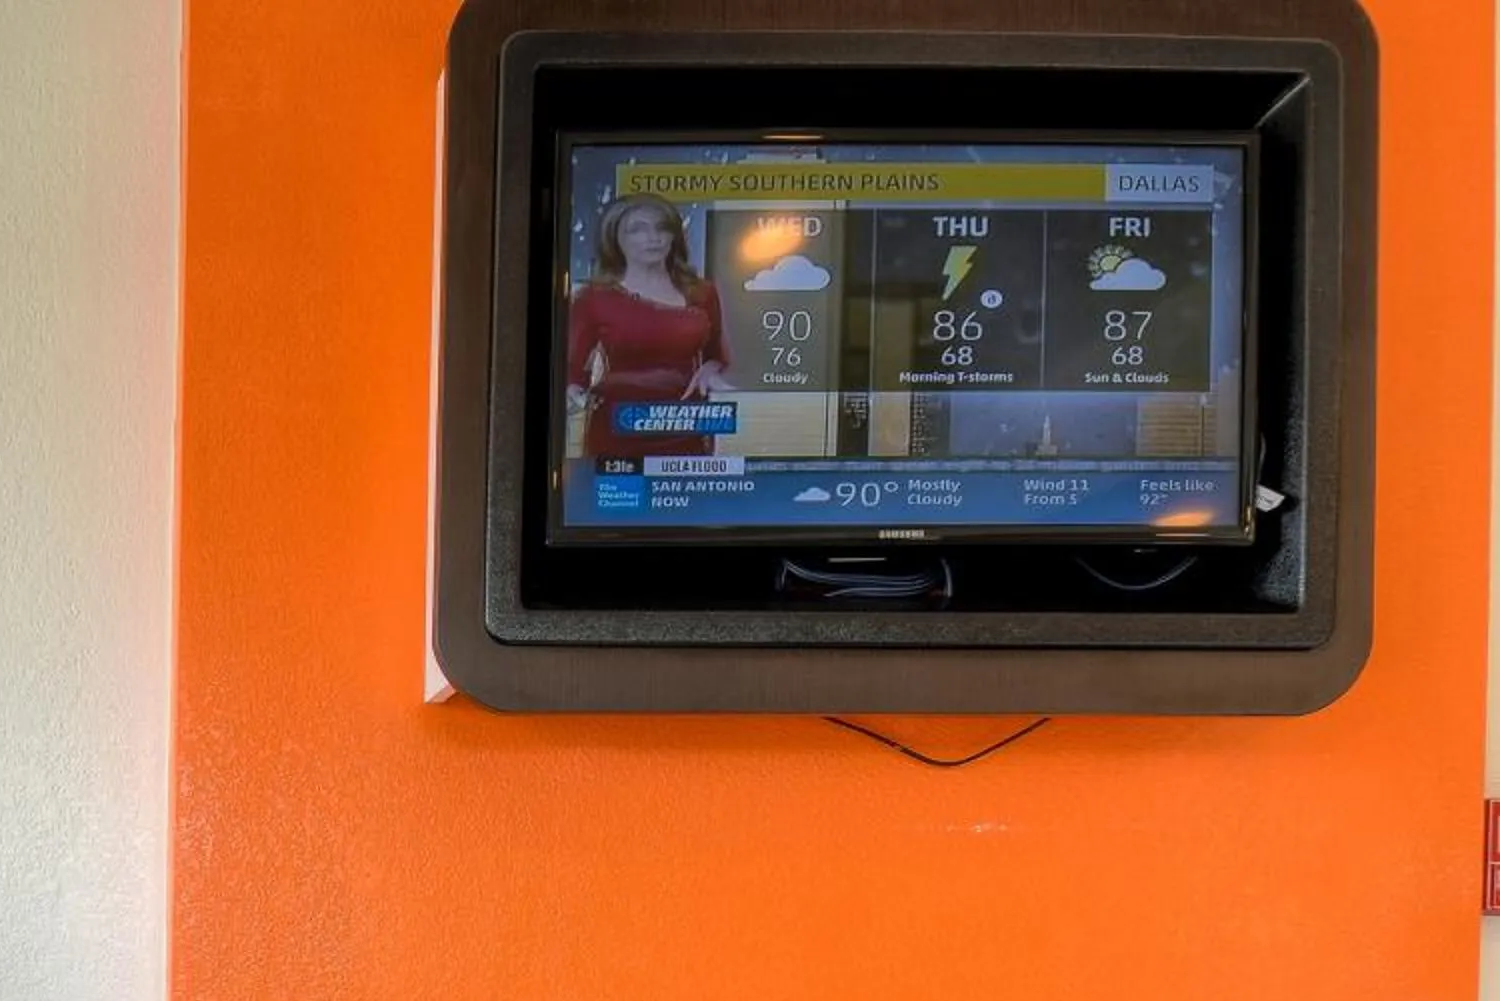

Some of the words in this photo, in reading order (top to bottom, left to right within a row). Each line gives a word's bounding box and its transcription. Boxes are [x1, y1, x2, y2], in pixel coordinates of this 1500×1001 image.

[630, 175, 722, 193] STORMY
[729, 174, 853, 192] SOUTHERN
[861, 173, 940, 191] PLAINS
[1118, 174, 1201, 192] DALLAS
[932, 216, 989, 238] THU
[1109, 216, 1151, 238] FRI
[762, 310, 812, 341] 90
[932, 310, 984, 342] 86
[1104, 310, 1153, 342] 87
[770, 347, 802, 367] 76
[940, 345, 974, 366] 68
[1110, 345, 1144, 366] 68
[762, 371, 809, 385] Cloudy
[899, 371, 954, 385] Morning
[958, 371, 1014, 384] T-storms
[1084, 371, 1109, 384] Sun
[1110, 371, 1123, 383] &
[1124, 371, 1169, 384] Clouds
[648, 404, 734, 419] WEATHER
[633, 418, 696, 432] CENTER
[651, 480, 682, 493] SAN
[685, 480, 756, 493] ANTONIO
[907, 478, 961, 493] Mostly
[1023, 478, 1065, 492] Wind
[1069, 479, 1089, 492] 11
[1140, 478, 1181, 492] Feels
[1184, 478, 1215, 492] like
[651, 496, 690, 508] NOW
[907, 493, 963, 507] Cloudy
[1023, 493, 1066, 505] From
